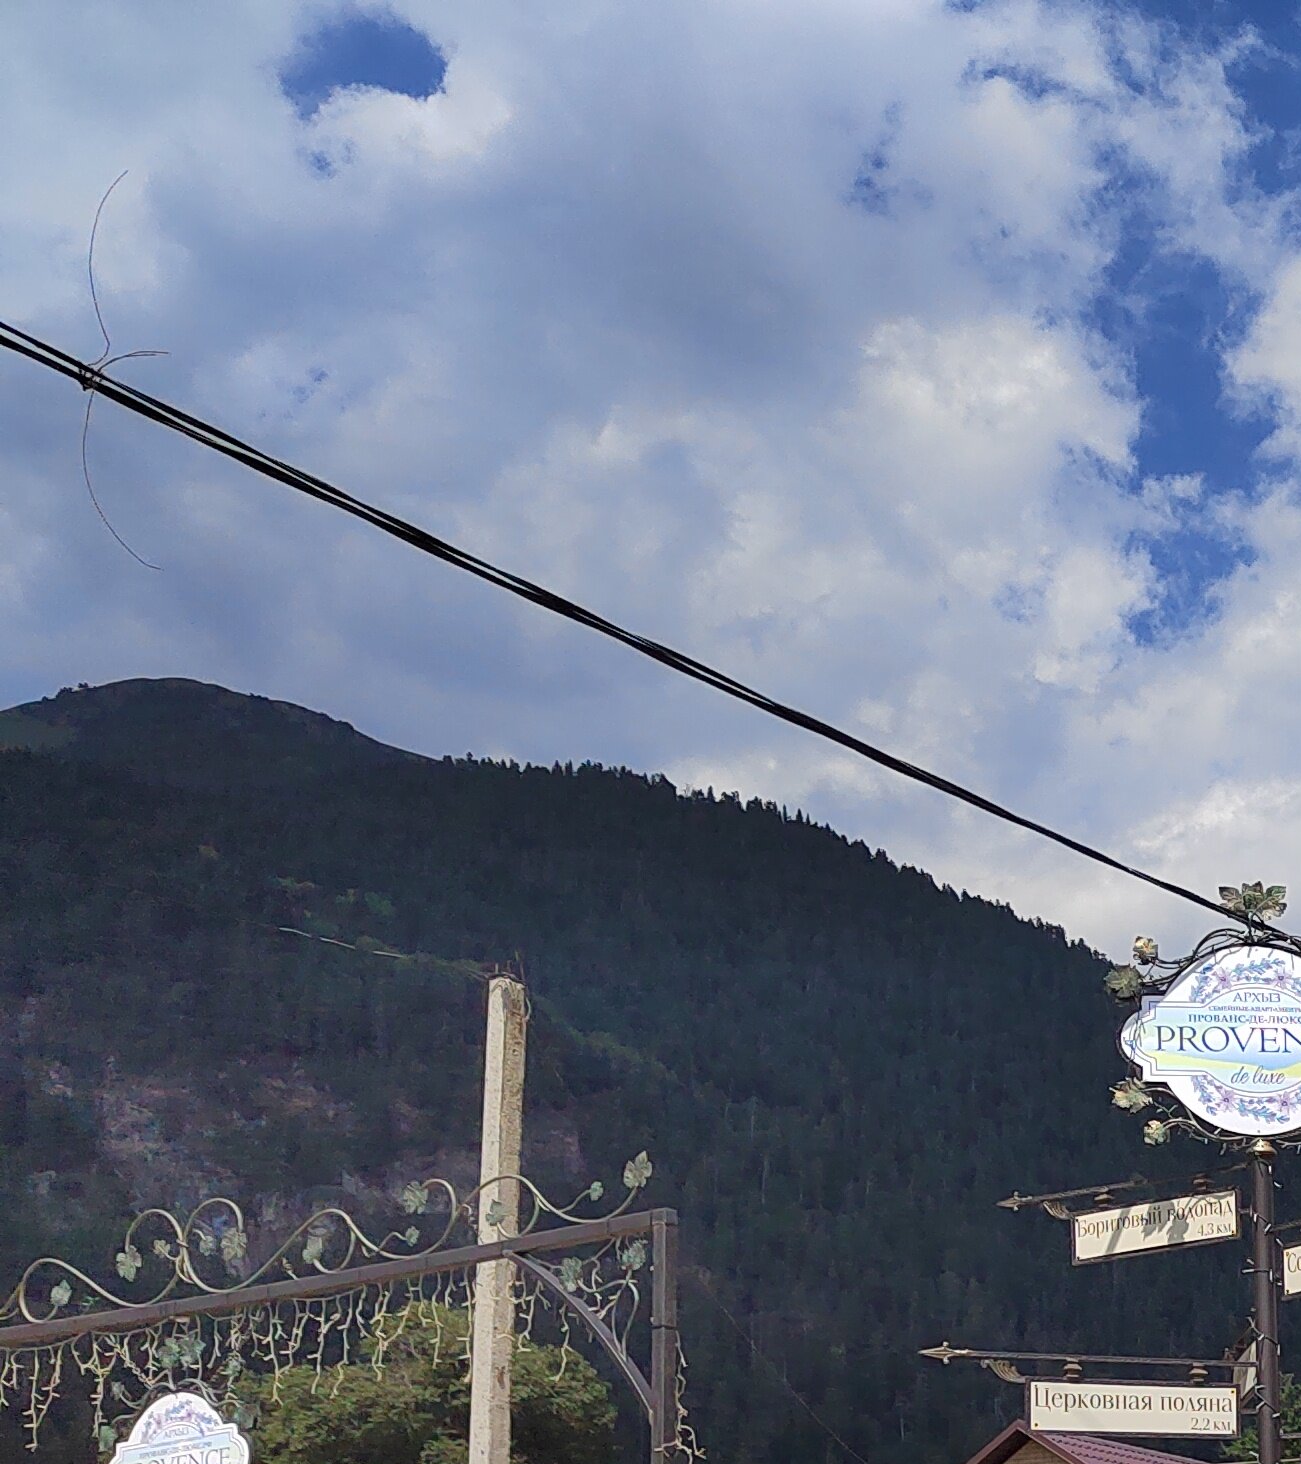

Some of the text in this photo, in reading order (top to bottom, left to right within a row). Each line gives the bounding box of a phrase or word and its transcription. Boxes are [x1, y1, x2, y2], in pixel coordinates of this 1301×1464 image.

[1232, 992, 1281, 1003] АРХЫЗ
[1230, 1065, 1286, 1085] de luxe
[1077, 1199, 1234, 1240] Боритовый водопад
[1034, 1384, 1233, 1413] Церковная поляна
